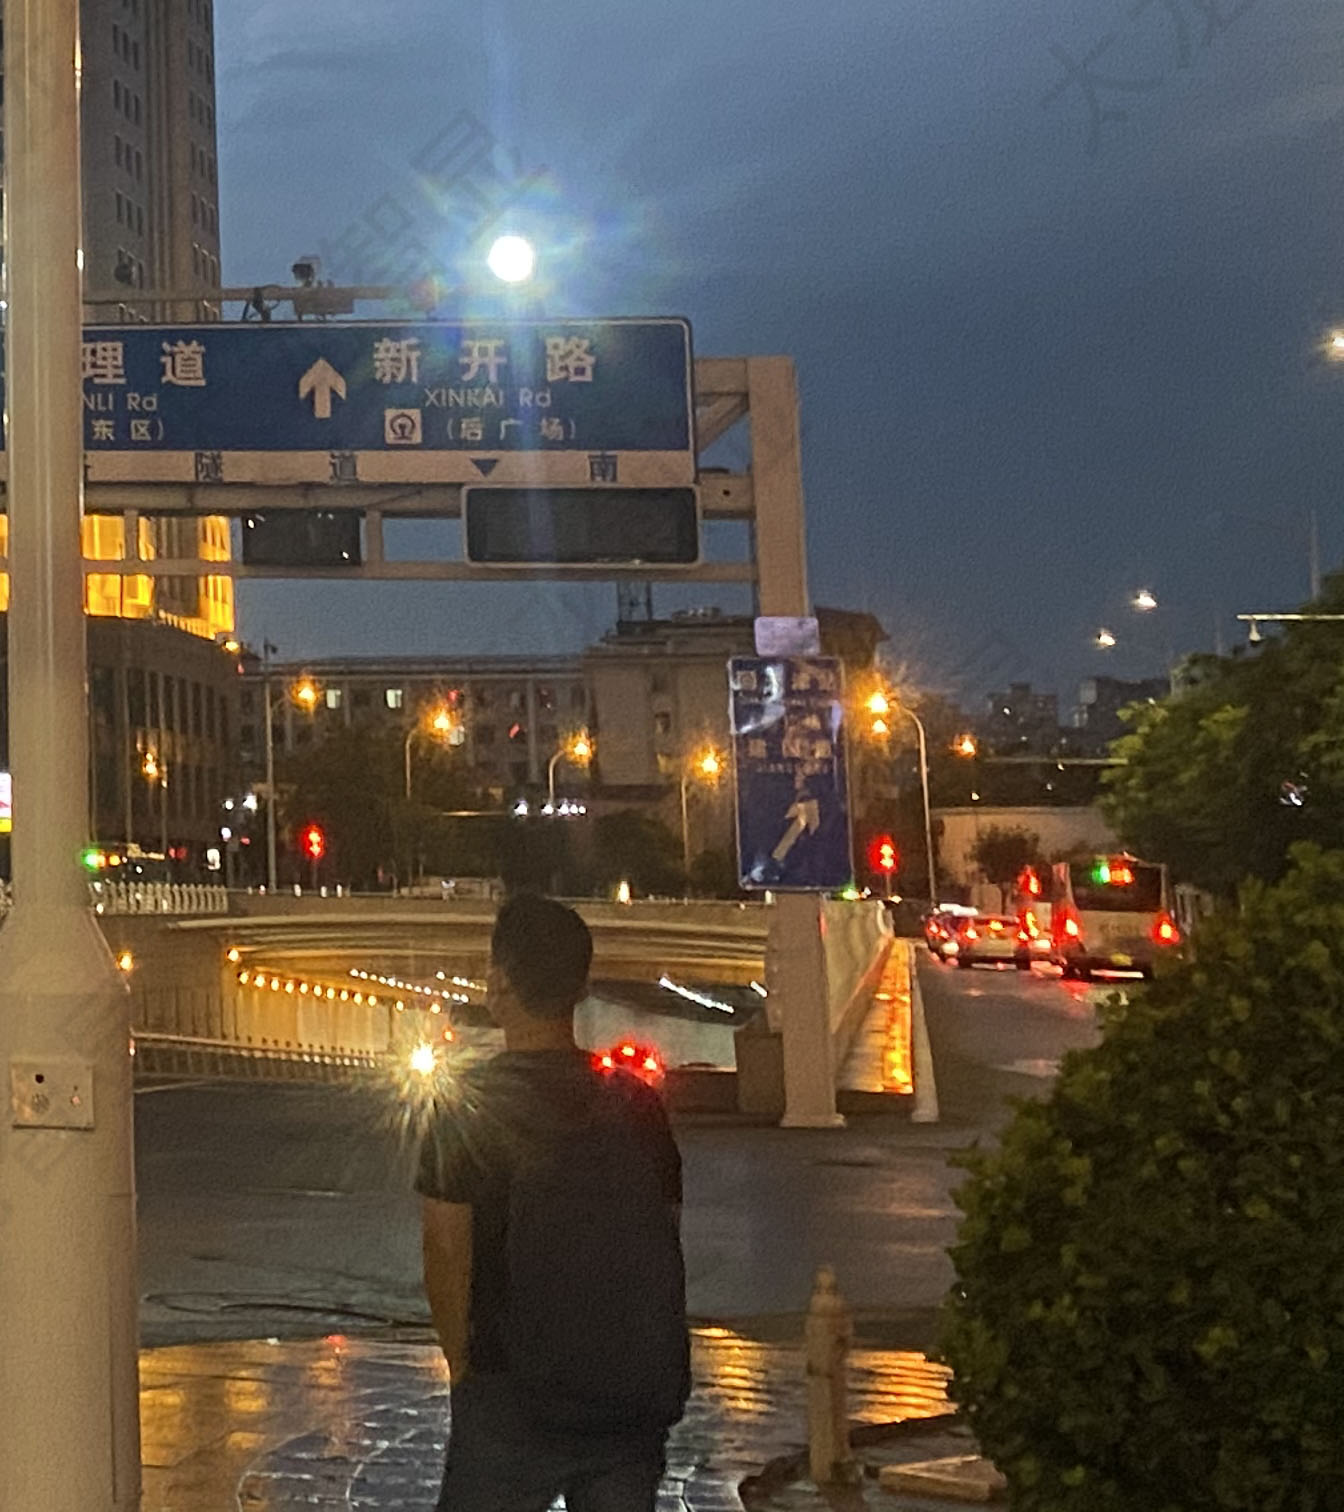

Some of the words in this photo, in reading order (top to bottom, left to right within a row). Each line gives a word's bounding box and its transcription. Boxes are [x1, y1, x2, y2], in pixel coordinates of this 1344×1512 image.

[80, 339, 207, 386] 理道
[373, 337, 597, 384] 新开路
[126, 391, 158, 412] Rd
[424, 387, 505, 408] XINKAI
[519, 388, 552, 408] Rd
[90, 418, 165, 442] 东区)
[587, 450, 619, 483] 南
